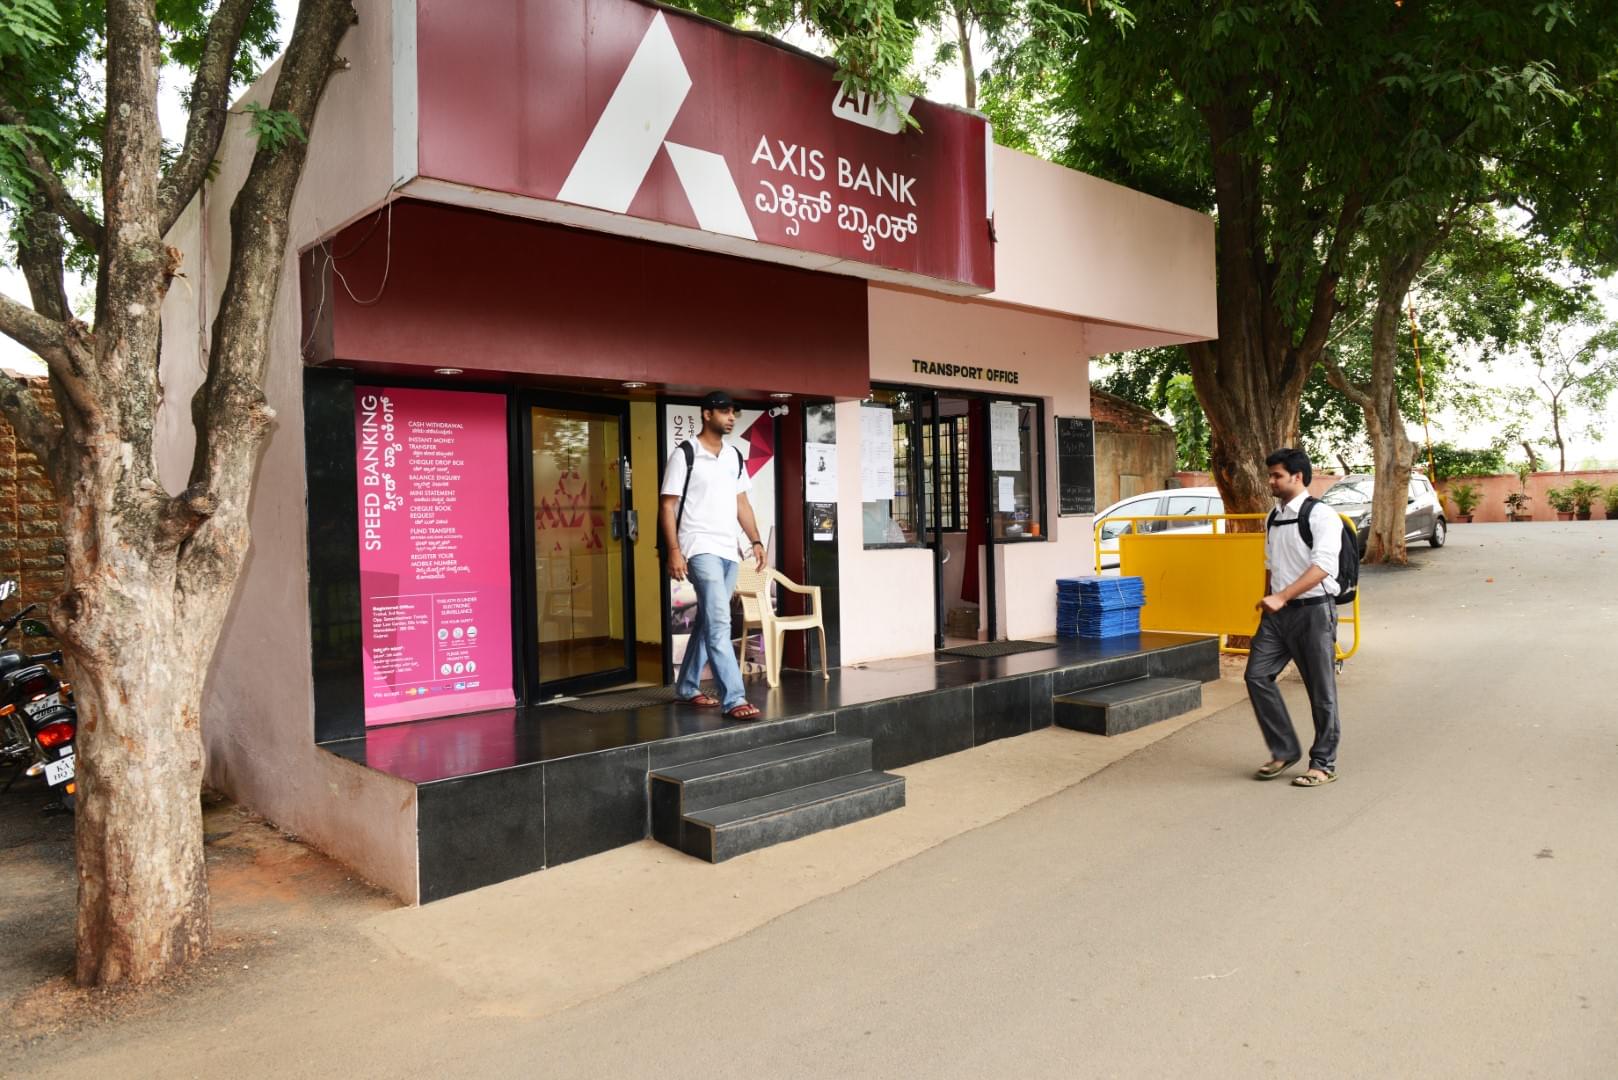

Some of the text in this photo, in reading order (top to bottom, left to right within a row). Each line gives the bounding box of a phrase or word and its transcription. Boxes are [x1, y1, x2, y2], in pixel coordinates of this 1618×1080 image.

[751, 134, 917, 207] AXIS BANK
[837, 203, 918, 251] ಬ್ಯಾಂಕ್
[912, 359, 1019, 385] TRANSPORT OFFICE
[362, 395, 381, 551] SPEED BANKING
